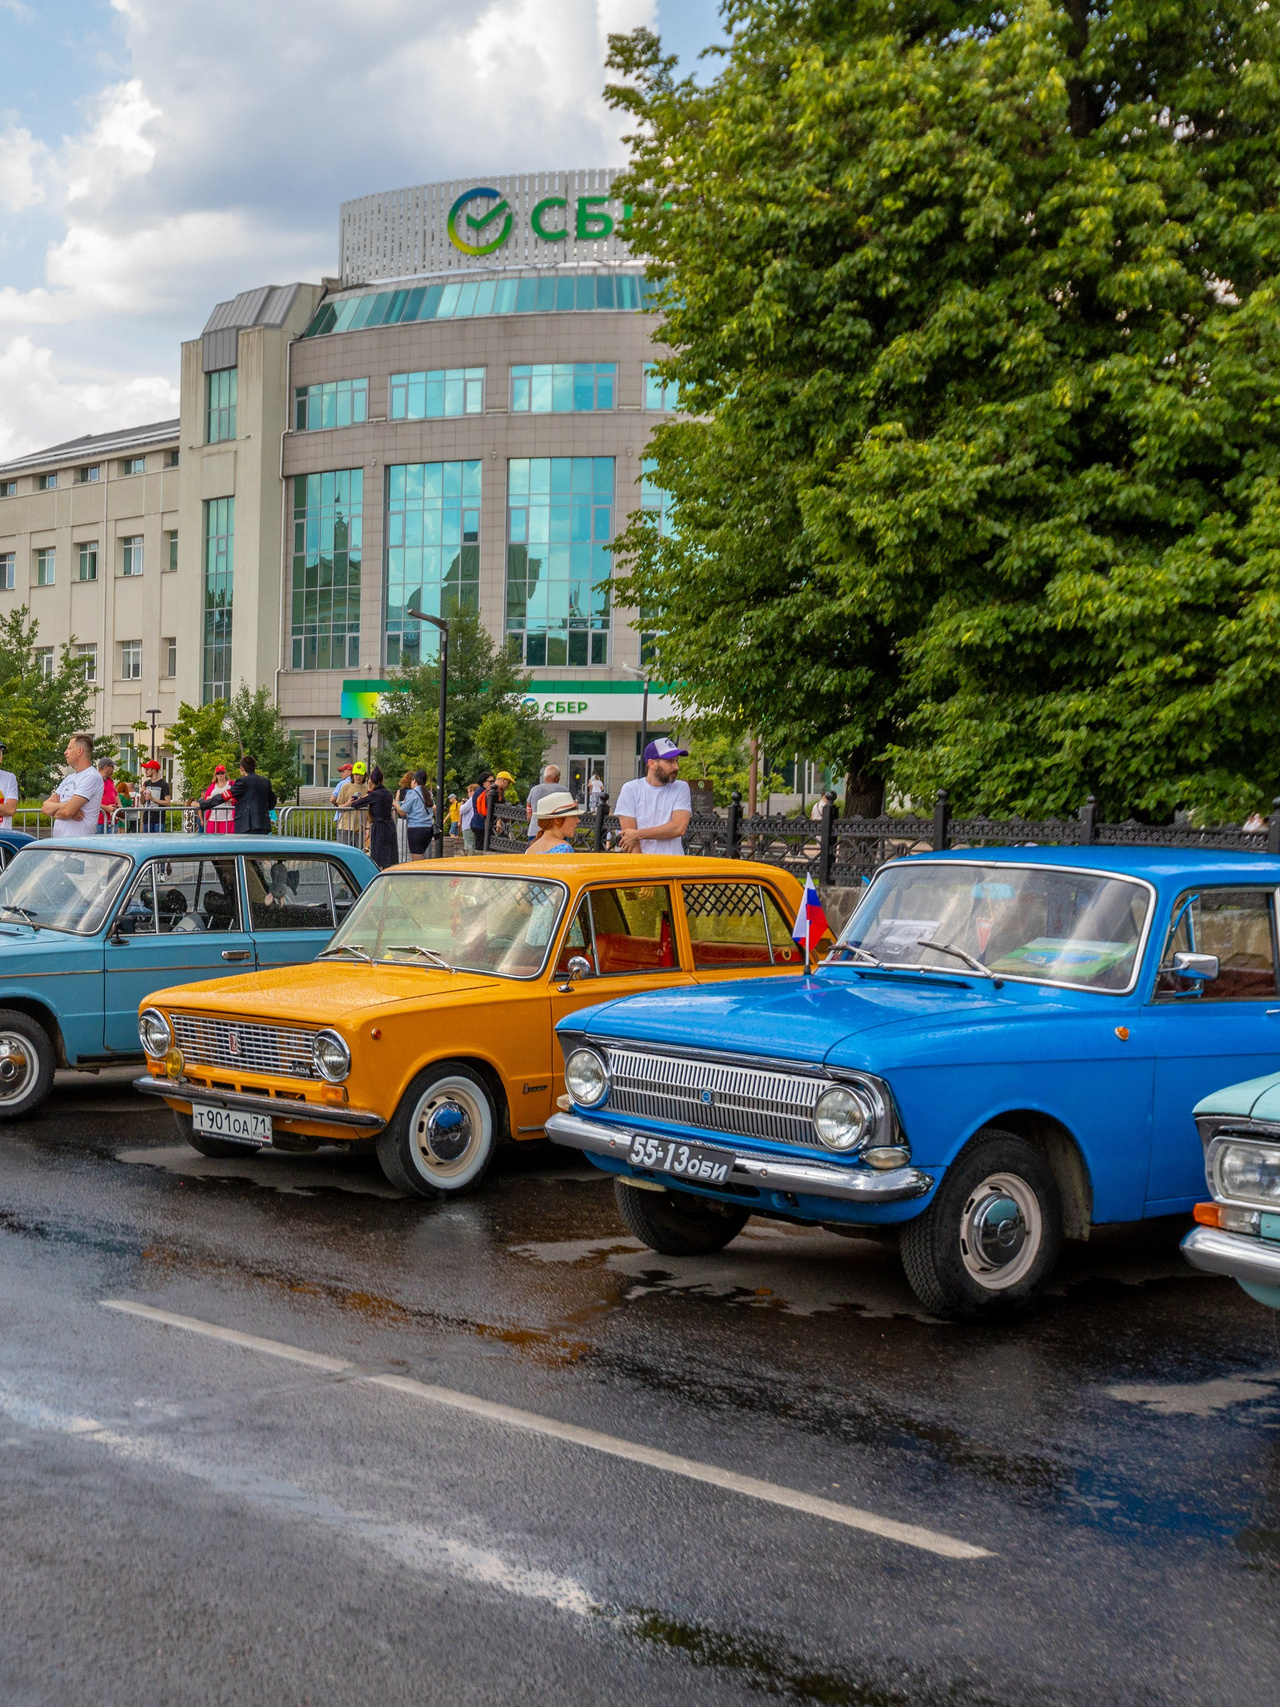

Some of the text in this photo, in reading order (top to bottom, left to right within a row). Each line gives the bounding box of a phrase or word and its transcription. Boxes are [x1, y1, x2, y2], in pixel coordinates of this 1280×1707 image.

[544, 701, 588, 714] СБЕР
[291, 1066, 310, 1075] LADA
[198, 1109, 266, 1136] Т901ОА 71
